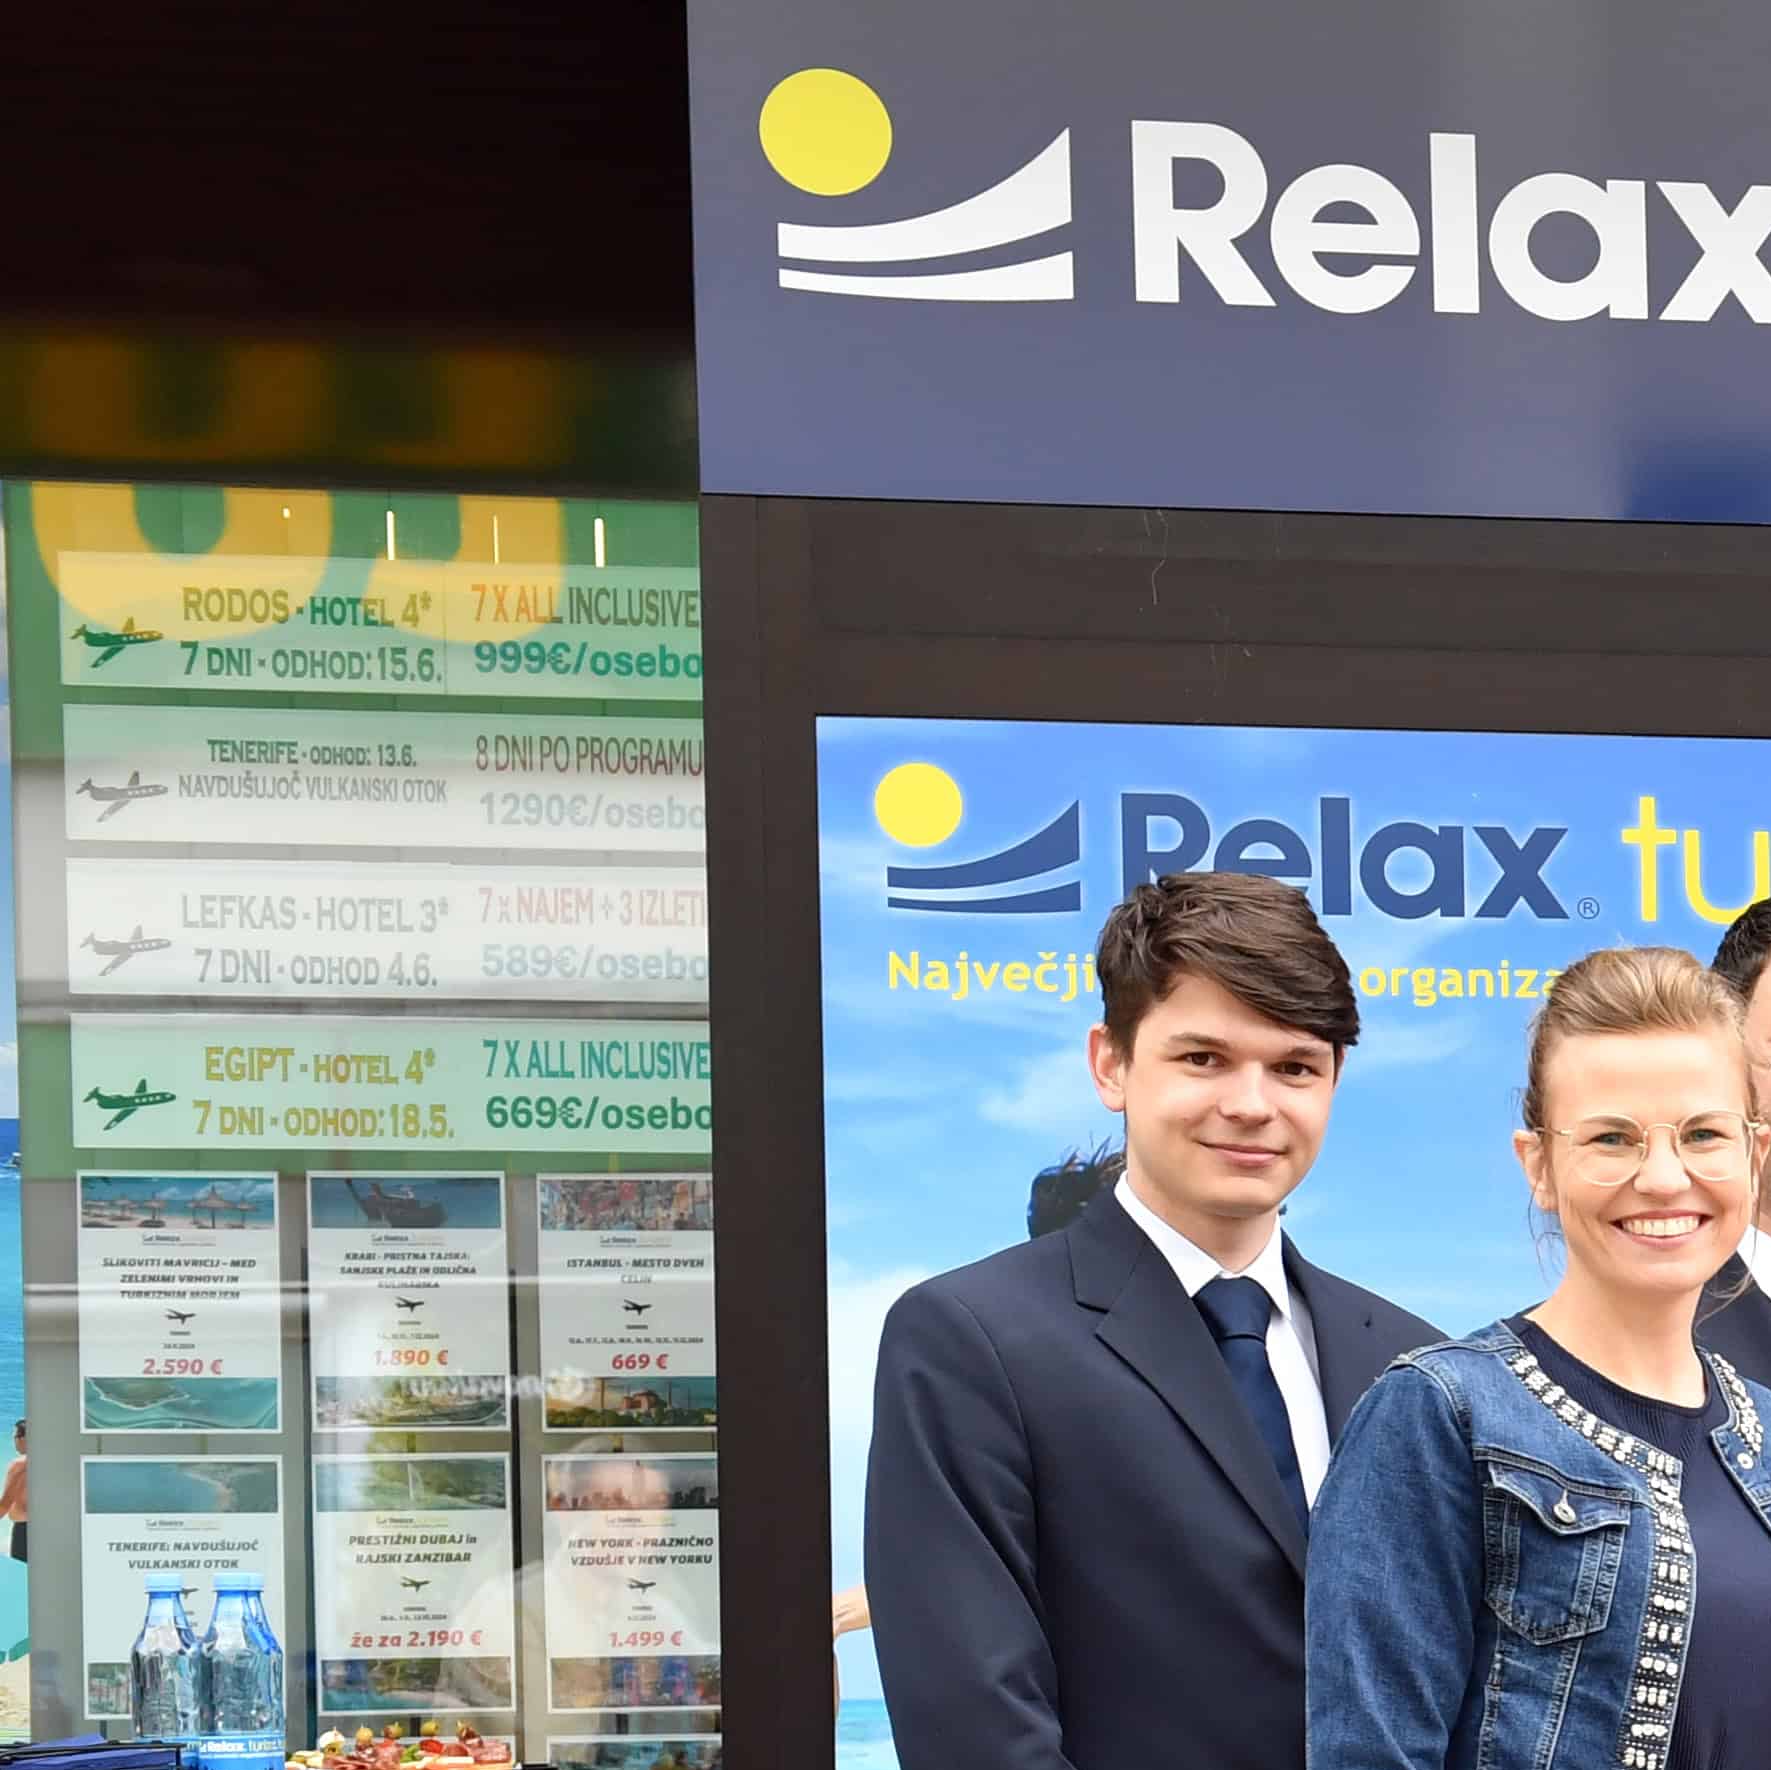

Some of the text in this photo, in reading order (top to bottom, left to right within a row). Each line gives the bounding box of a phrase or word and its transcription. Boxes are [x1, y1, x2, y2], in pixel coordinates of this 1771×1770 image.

[182, 587, 290, 623] RODOS
[309, 596, 395, 628] HOTEL
[471, 583, 486, 622] 7
[515, 585, 563, 624] ALL
[568, 587, 700, 628] INCLUSIVE
[180, 640, 199, 675] 7
[207, 647, 252, 677] DNI
[474, 641, 704, 679] 999€/osebo
[207, 739, 299, 765] TENERIFE
[377, 744, 417, 767] 13.6.
[476, 735, 704, 776] 8 DNI PO PROGRAMU
[178, 770, 447, 803] NAVDUŠUJOČ VULKANSKI OTOK
[181, 894, 297, 930] LEFKAS
[316, 895, 414, 932] HOTEL
[478, 887, 492, 924] 7
[517, 886, 594, 925] NAJEM
[620, 890, 633, 926] 3
[194, 948, 438, 987] 7 DNI ODHOD 4.6.
[888, 950, 1096, 1002] Največji
[204, 1046, 295, 1082] EGIPT
[313, 1054, 399, 1085] HOTEL
[482, 1039, 712, 1080] 7 X ALL INCLUSIVE
[192, 1099, 211, 1135] 7
[219, 1106, 264, 1136] DNI
[230, 1259, 257, 1269] MED
[567, 1258, 704, 1268] ISTANBUL MESTO DVEH
[142, 1358, 224, 1375] 2.590 €
[374, 1349, 431, 1366] 1.890
[612, 1353, 669, 1370] 669 €
[419, 1534, 463, 1545] DUBAJ
[643, 1535, 714, 1548] PRAZNIČNO
[128, 1559, 240, 1569] VULKANSKI OTOK
[351, 1631, 373, 1648] že
[378, 1634, 402, 1648] za
[407, 1630, 464, 1648] 2.190
[608, 1631, 665, 1648] 1.499
